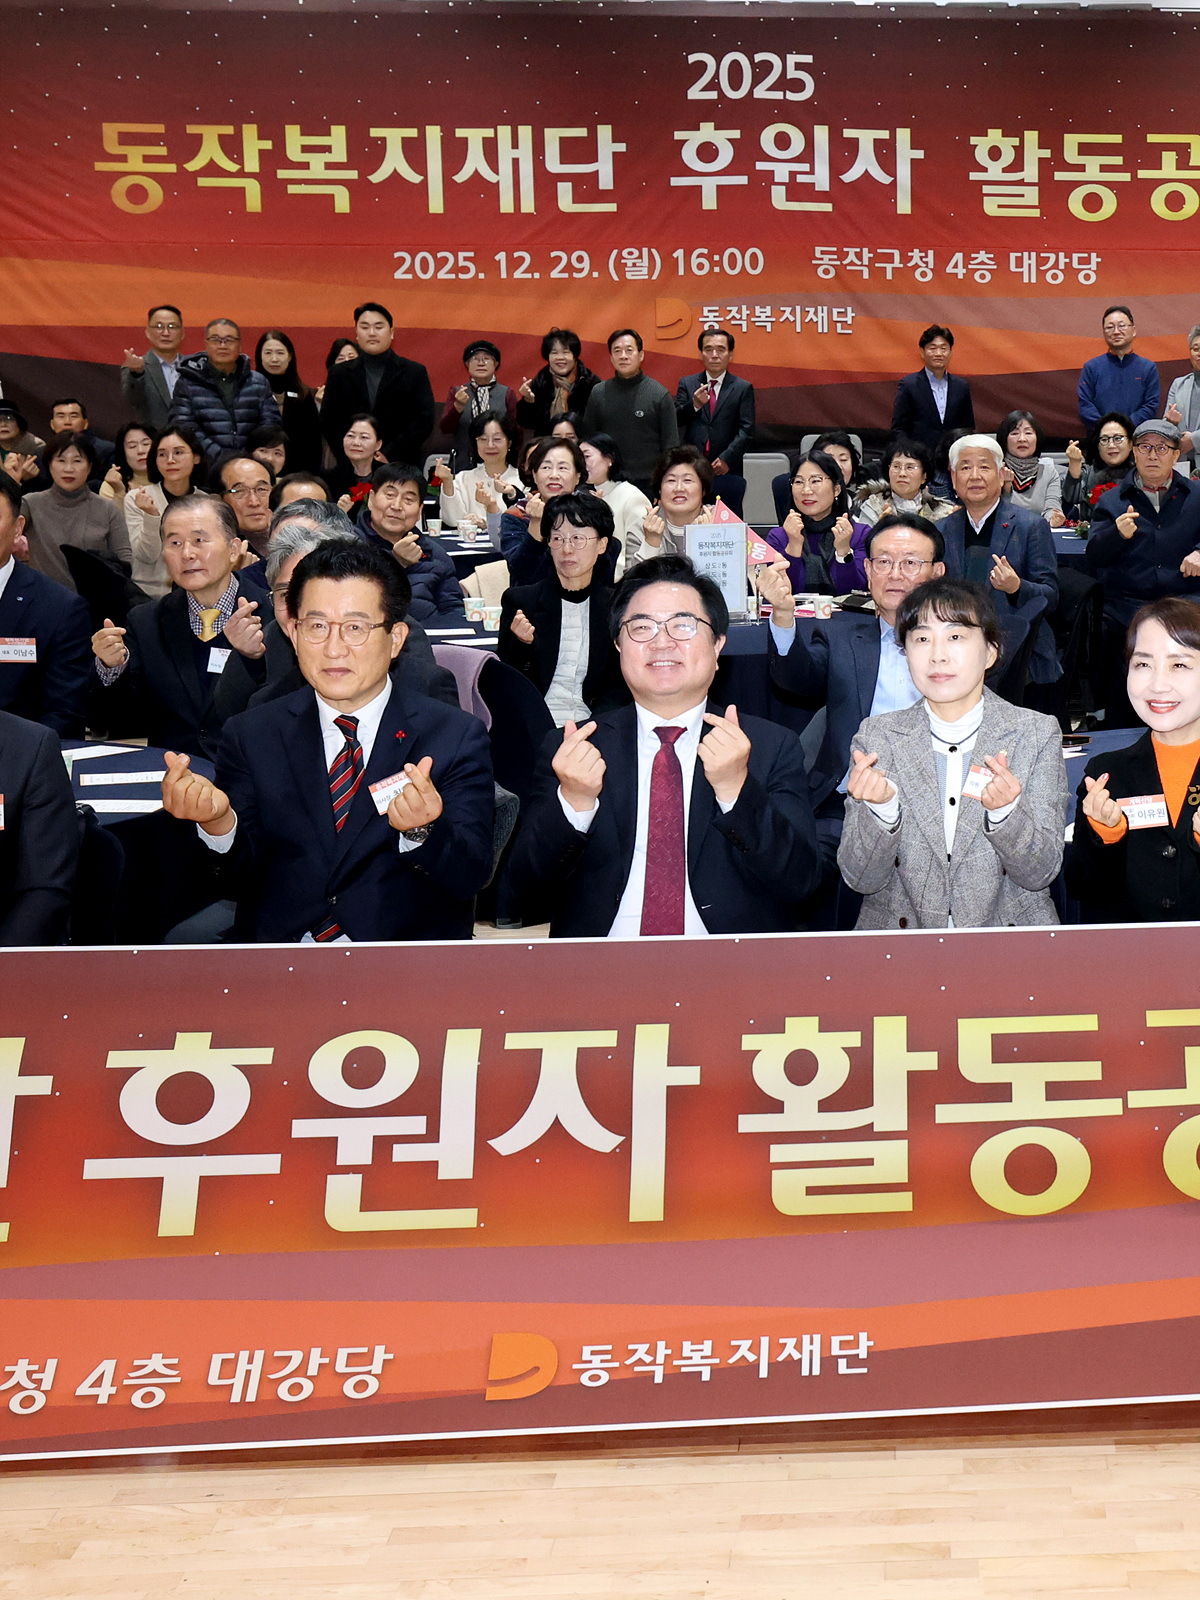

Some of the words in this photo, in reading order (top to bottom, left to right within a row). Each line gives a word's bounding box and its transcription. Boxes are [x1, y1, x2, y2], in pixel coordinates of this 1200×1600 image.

[686, 52, 815, 102] 2025
[94, 122, 627, 215] 동작복지재단
[669, 120, 925, 215] 후원자
[393, 251, 485, 280] 2025.
[494, 251, 540, 279] 12.
[550, 250, 599, 279] 29.
[608, 247, 661, 281] (월)
[672, 247, 765, 276] 16:00
[811, 246, 934, 283] 동작구청
[945, 250, 998, 284] 4층
[1009, 251, 1102, 285] 대강당
[698, 304, 856, 333] 동작복지재단
[698, 541, 734, 550] 동작복지재단
[13, 649, 35, 657] 이남수
[1137, 808, 1166, 820] 이유원
[83, 1021, 701, 1238] 후원자
[75, 1353, 182, 1409] 4층
[206, 1344, 395, 1403] 대강당
[572, 1331, 875, 1388] 동작복지재단
